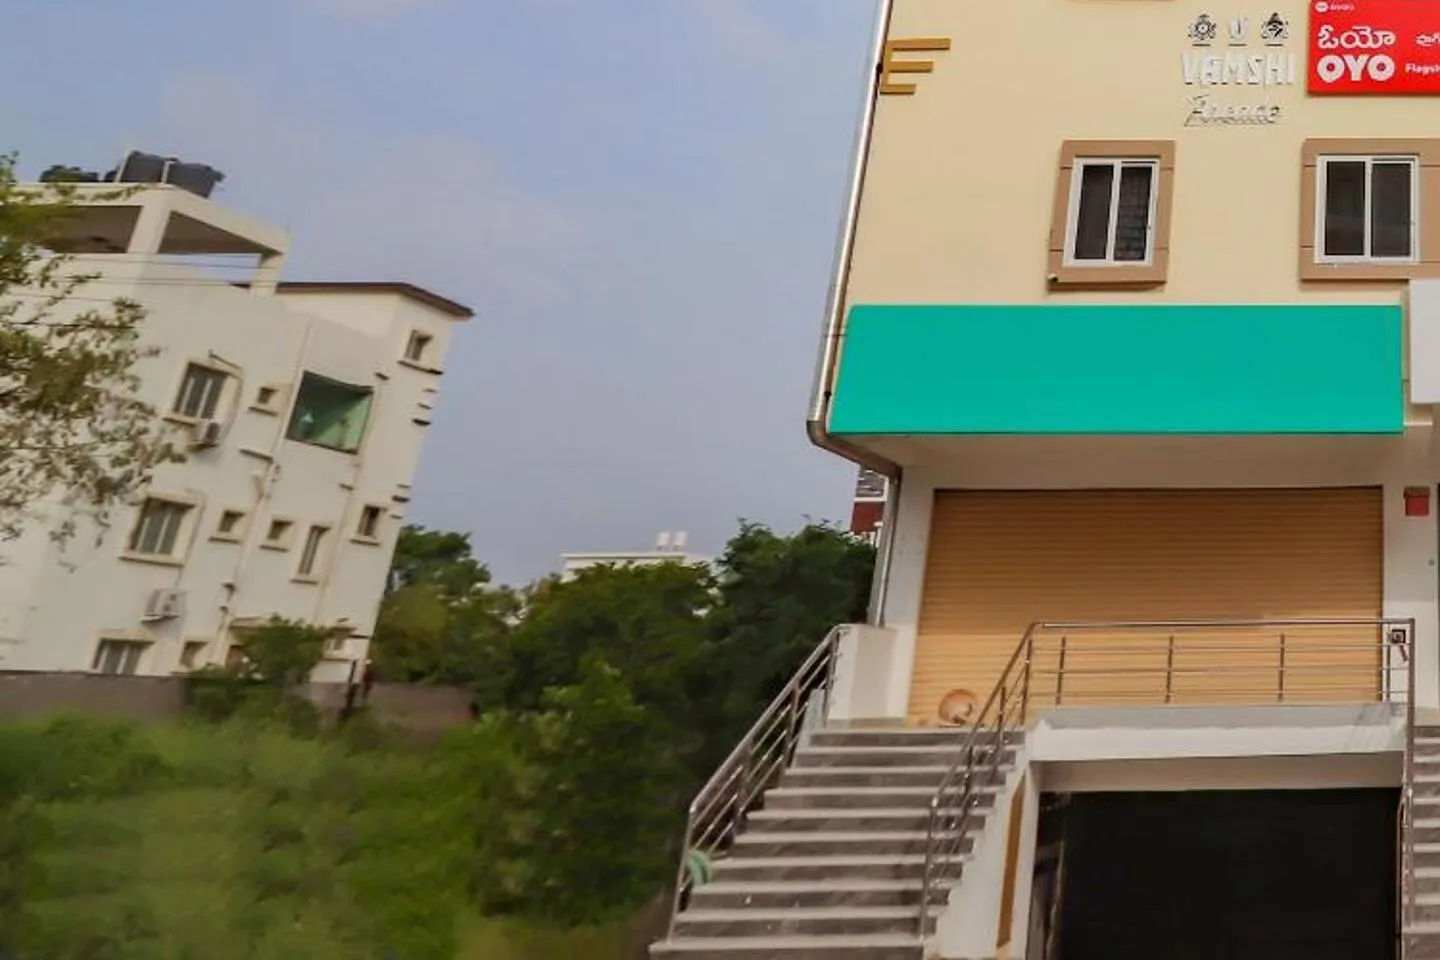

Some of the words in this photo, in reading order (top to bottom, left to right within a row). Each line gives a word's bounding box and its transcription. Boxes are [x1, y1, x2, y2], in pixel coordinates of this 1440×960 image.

[1318, 24, 1396, 50] ఓయో
[1181, 52, 1294, 85] VAMSHI
[1317, 53, 1396, 83] OYO
